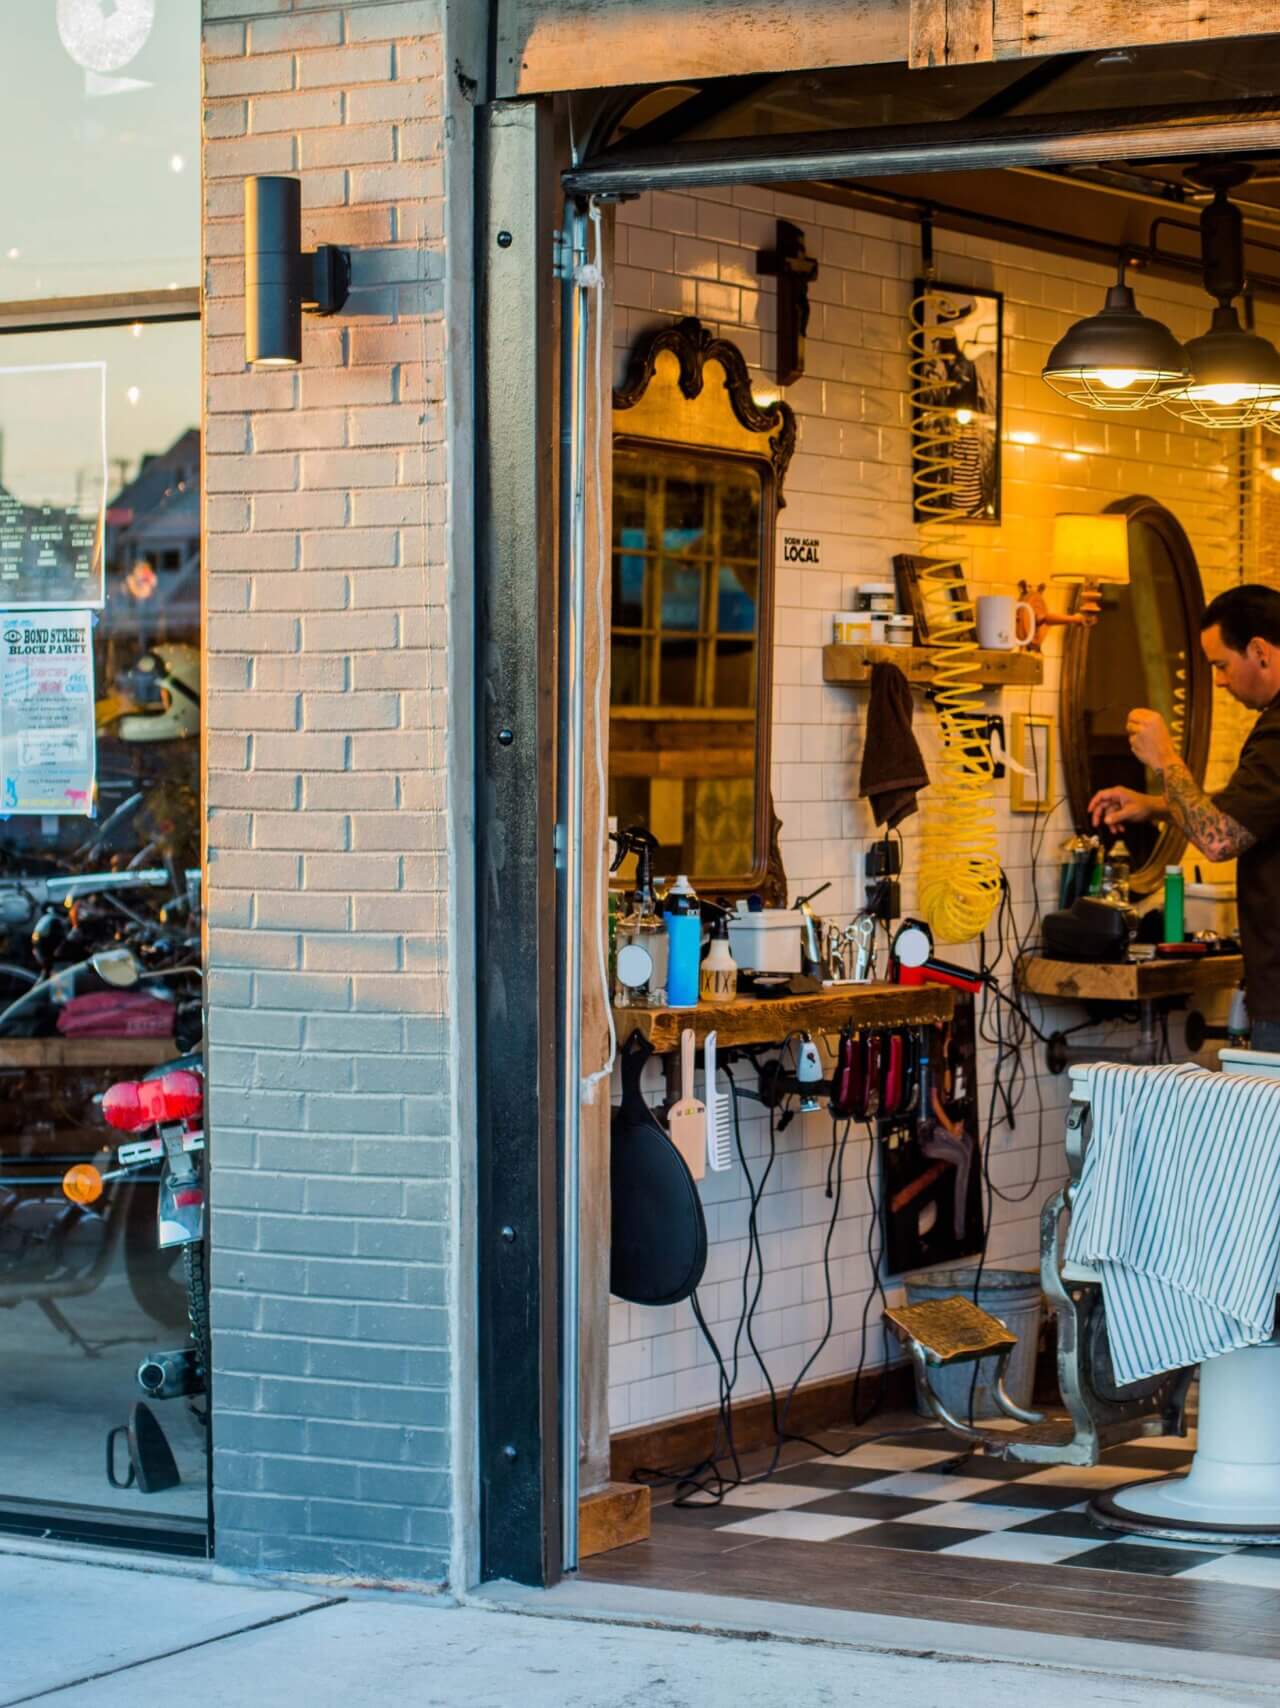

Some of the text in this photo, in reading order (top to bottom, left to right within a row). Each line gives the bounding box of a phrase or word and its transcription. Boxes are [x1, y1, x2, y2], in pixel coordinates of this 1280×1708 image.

[784, 545, 819, 563] LOCAL
[24, 628, 85, 644] BOND STREET
[8, 645, 86, 655] BLOCK PARTY
